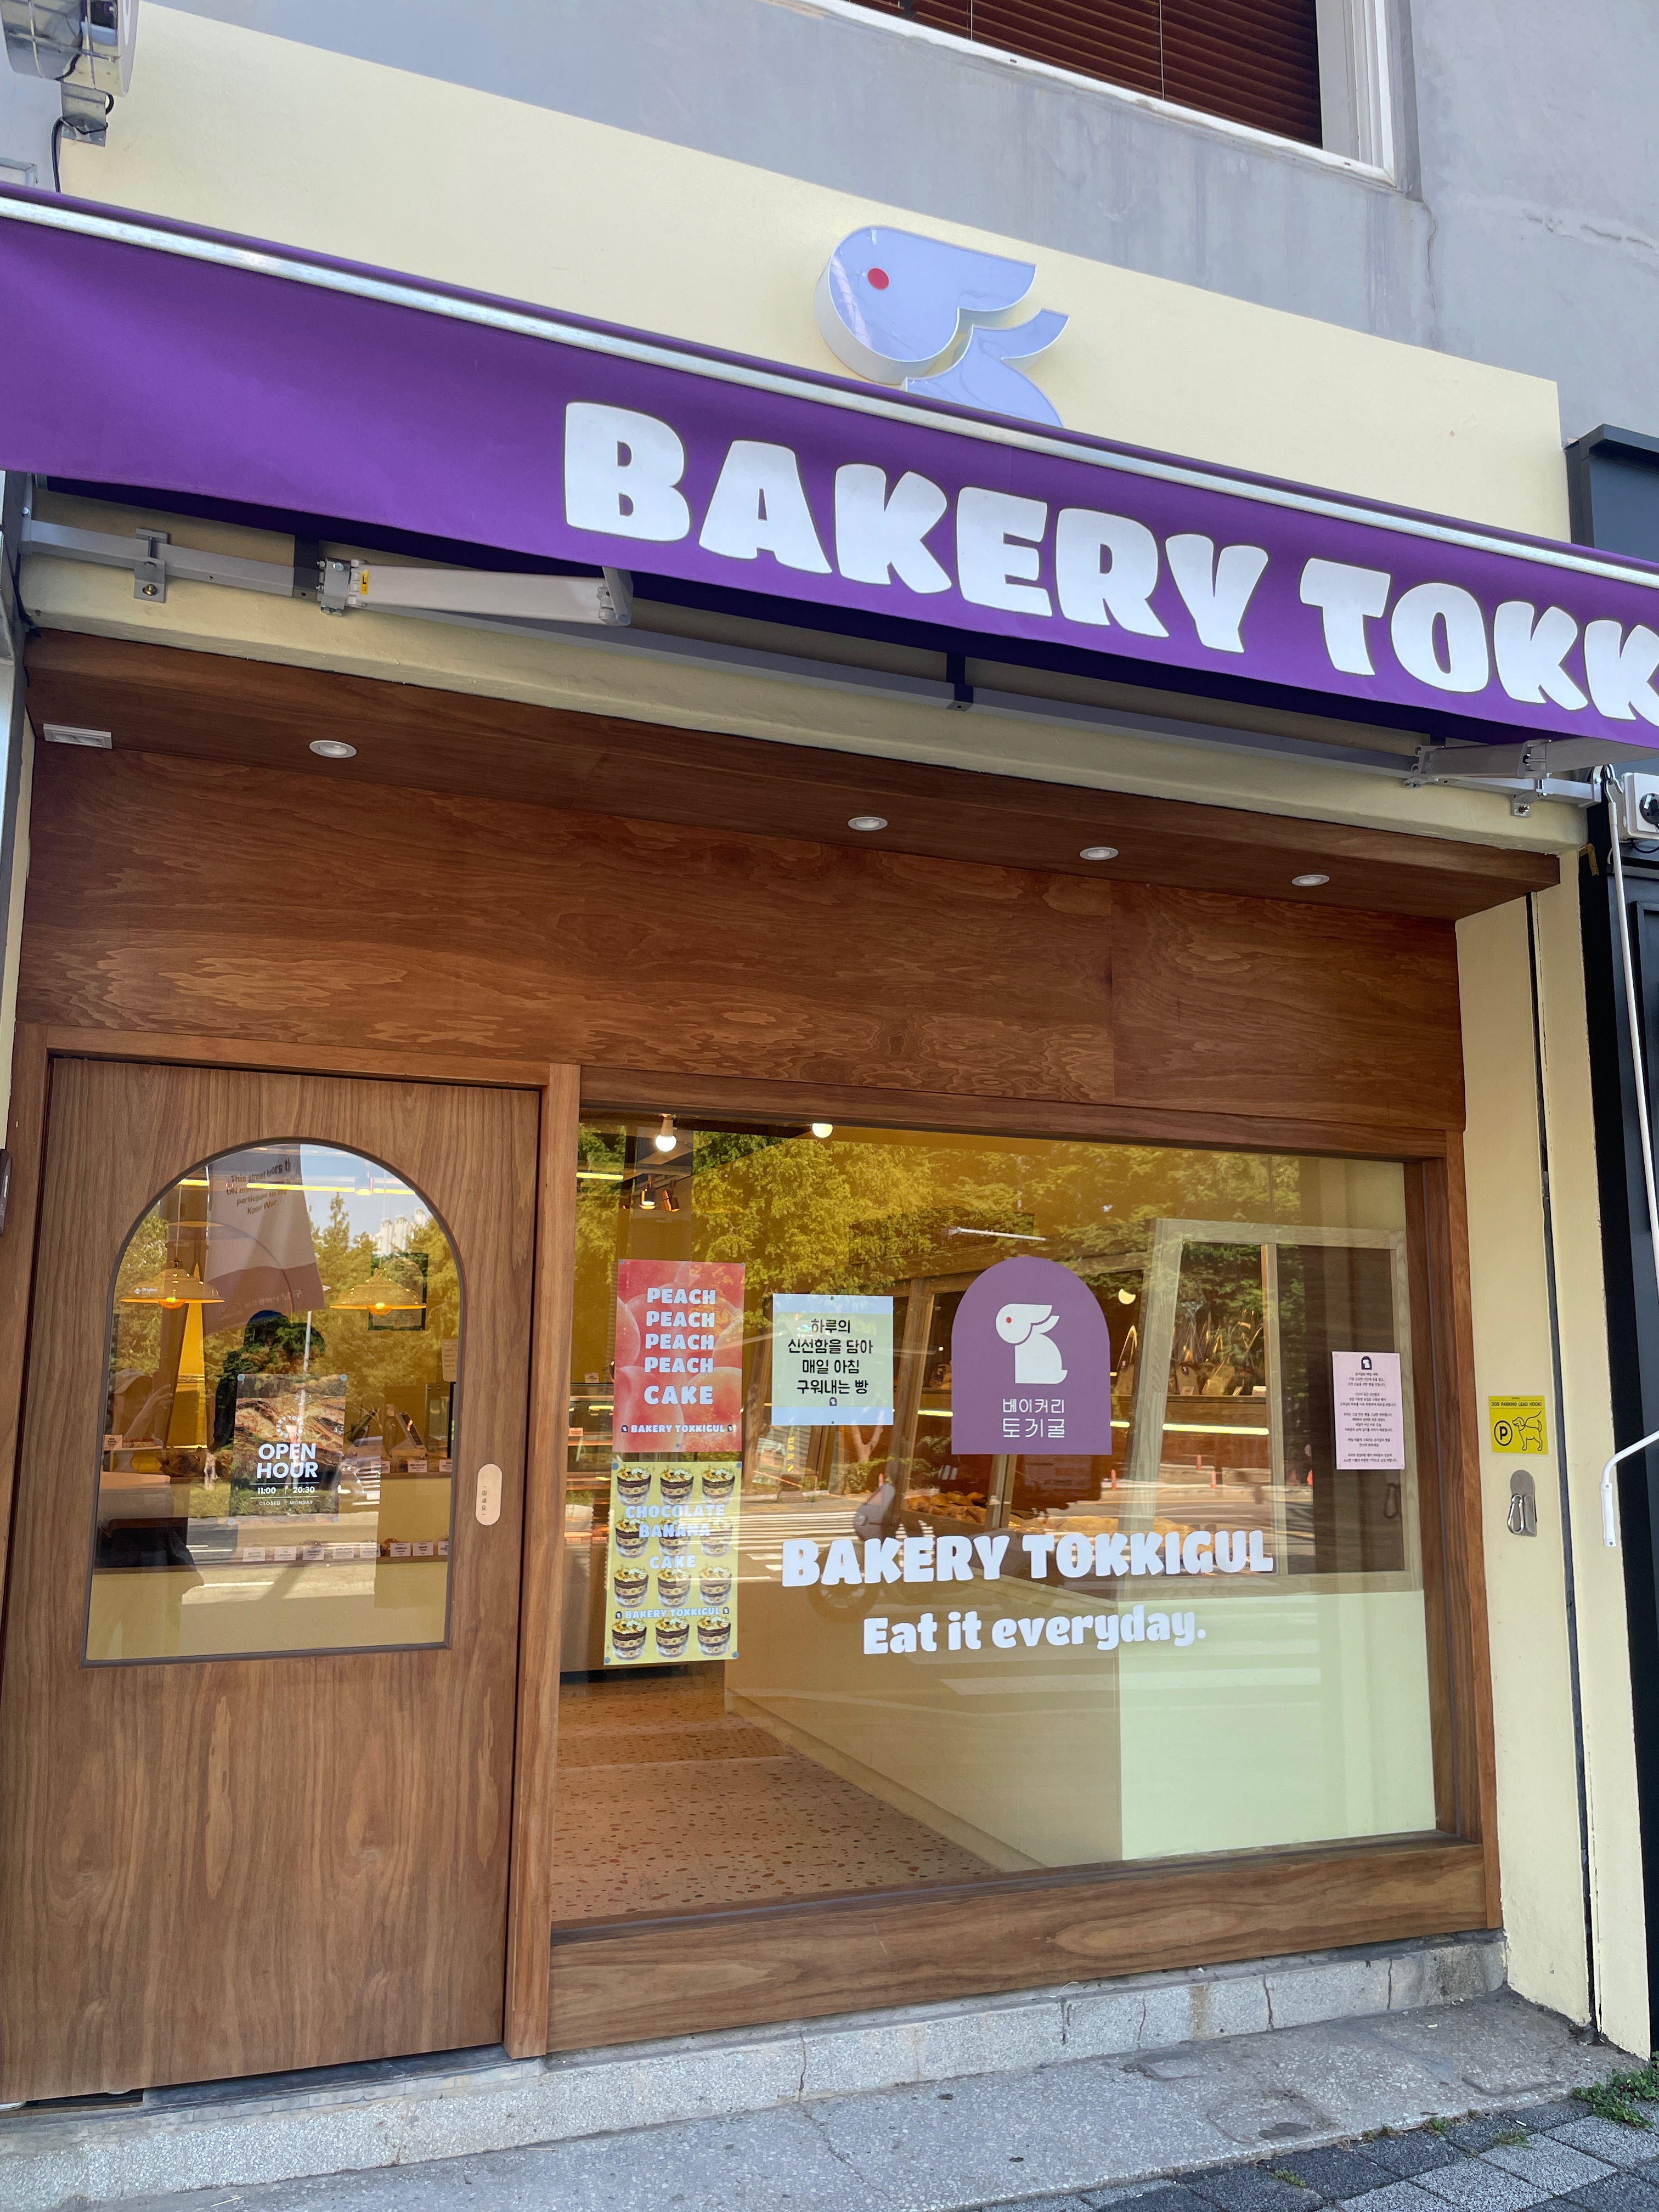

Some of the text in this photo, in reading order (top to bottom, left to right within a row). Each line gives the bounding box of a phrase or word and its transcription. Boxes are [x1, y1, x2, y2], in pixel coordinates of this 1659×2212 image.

[565, 401, 1659, 726] BAKERY TOKK
[230, 1174, 247, 1183] This
[647, 1288, 716, 1305] PEACH
[646, 1311, 715, 1328] PEACH
[811, 1318, 851, 1334] 하루의
[645, 1333, 715, 1350] PEACH
[788, 1339, 874, 1354] 신선함을 담아
[645, 1357, 714, 1374] PEACH
[802, 1359, 860, 1374] 매일 아침
[797, 1379, 869, 1394] 구워내는 빵
[644, 1385, 714, 1405] CAKE
[1002, 1398, 1065, 1414] 베이커리
[631, 1424, 725, 1433] BAKERY TOKKIGUL
[1002, 1418, 1065, 1438] 토끼굴
[1499, 1426, 1508, 1441] P
[258, 1443, 317, 1460] OPEN
[256, 1462, 319, 1479] HOUR
[292, 1486, 315, 1494] 20:30
[625, 1504, 725, 1519] CHOCOLATE
[639, 1523, 711, 1538] BANANA
[650, 1555, 696, 1570] CAKE
[782, 1530, 1274, 1587] BAKERY TOKKIGUL
[625, 1607, 721, 1618] BAKERY TOKKIGUL
[864, 1604, 1206, 1655] Eat it everyday.
